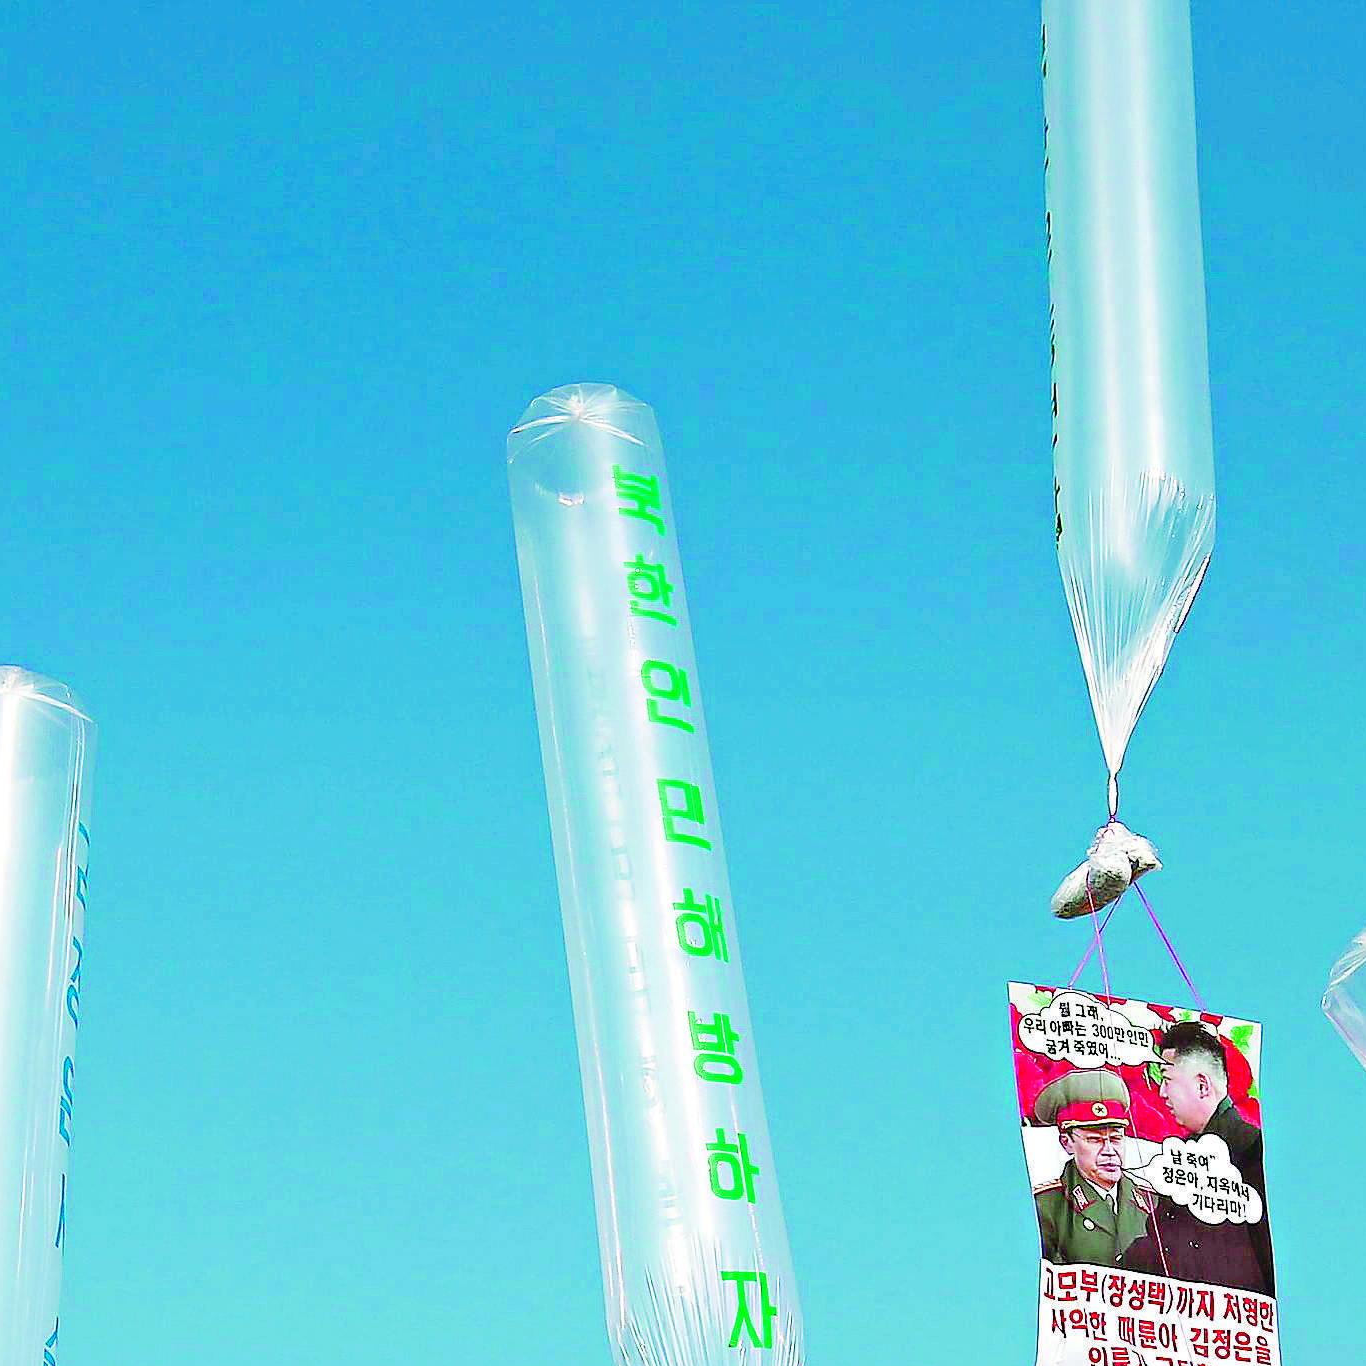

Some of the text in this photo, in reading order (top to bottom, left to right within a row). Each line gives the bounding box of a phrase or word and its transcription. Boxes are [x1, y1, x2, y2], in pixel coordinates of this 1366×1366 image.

[1023, 1018, 1046, 1035] 우리
[1050, 1020, 1086, 1037] 아빠는
[1206, 1175, 1250, 1202] 지옥에서
[1192, 1193, 1247, 1218] 기다리마!
[1118, 1316, 1178, 1352] 패륜아
[1190, 1327, 1272, 1366] 김정은을
